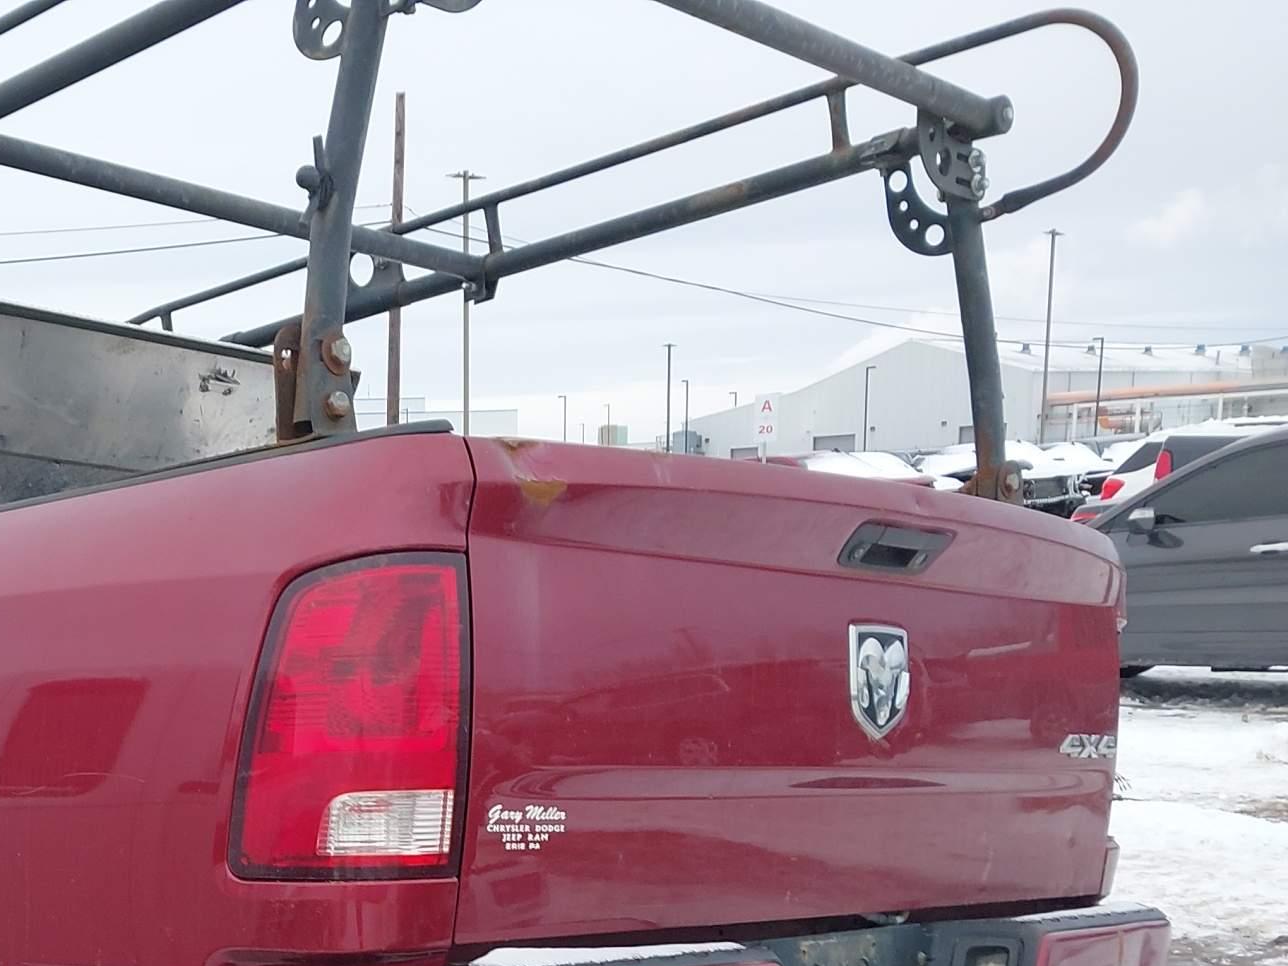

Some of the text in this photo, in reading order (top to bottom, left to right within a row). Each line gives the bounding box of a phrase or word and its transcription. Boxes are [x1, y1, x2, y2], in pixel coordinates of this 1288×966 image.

[761, 399, 773, 413] A
[758, 424, 774, 434] 20
[488, 804, 566, 824] Gary Miller
[486, 824, 565, 833] CHRYSLER DODGE
[502, 833, 523, 843] JEEP
[505, 842, 541, 851] ERIE PA
